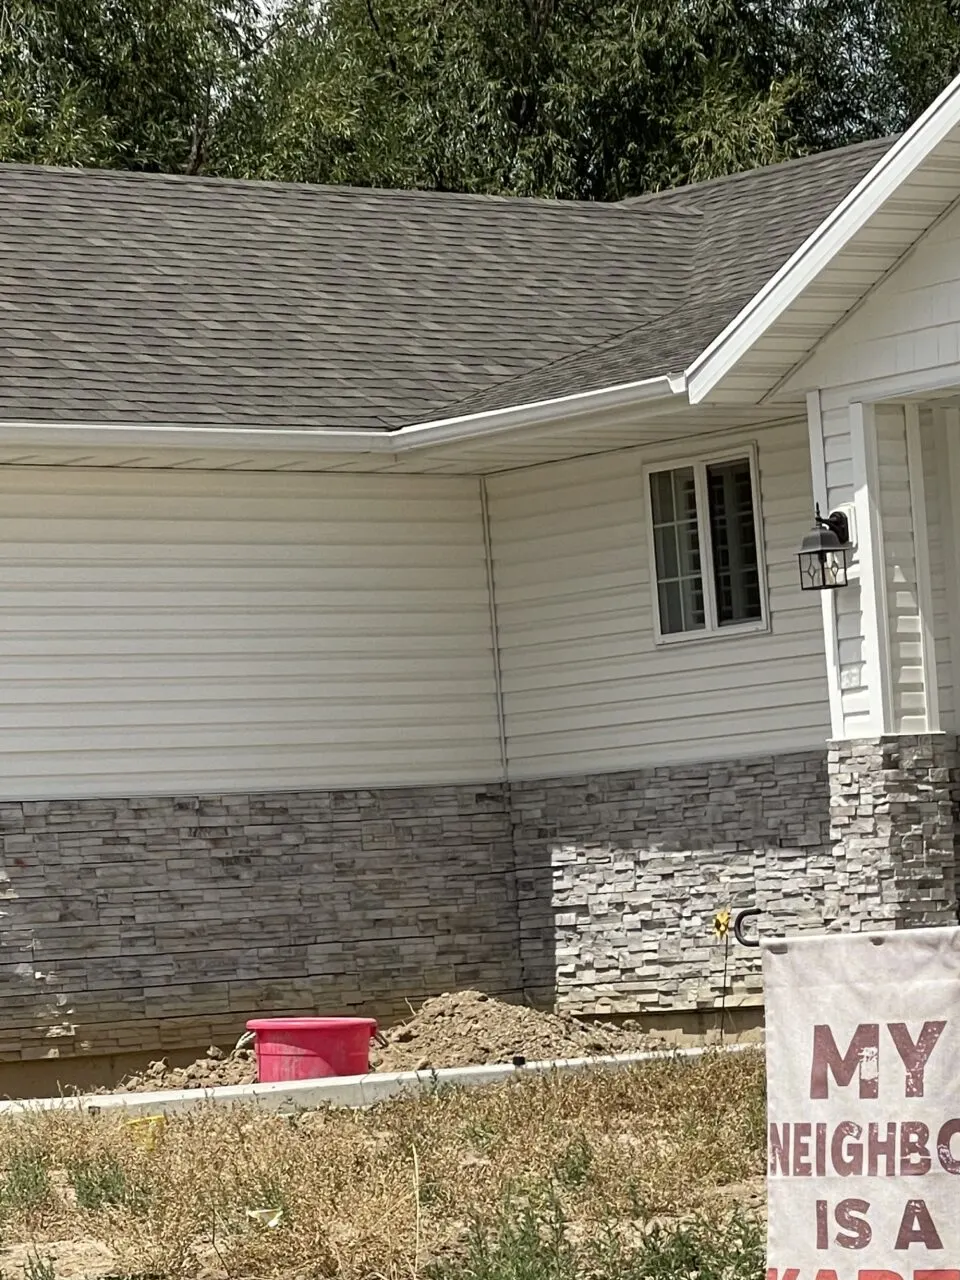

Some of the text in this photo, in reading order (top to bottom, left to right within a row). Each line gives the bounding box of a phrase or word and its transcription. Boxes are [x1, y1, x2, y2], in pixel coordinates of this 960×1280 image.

[810, 1020, 948, 1099] MY
[815, 1198, 944, 1250] IS A
